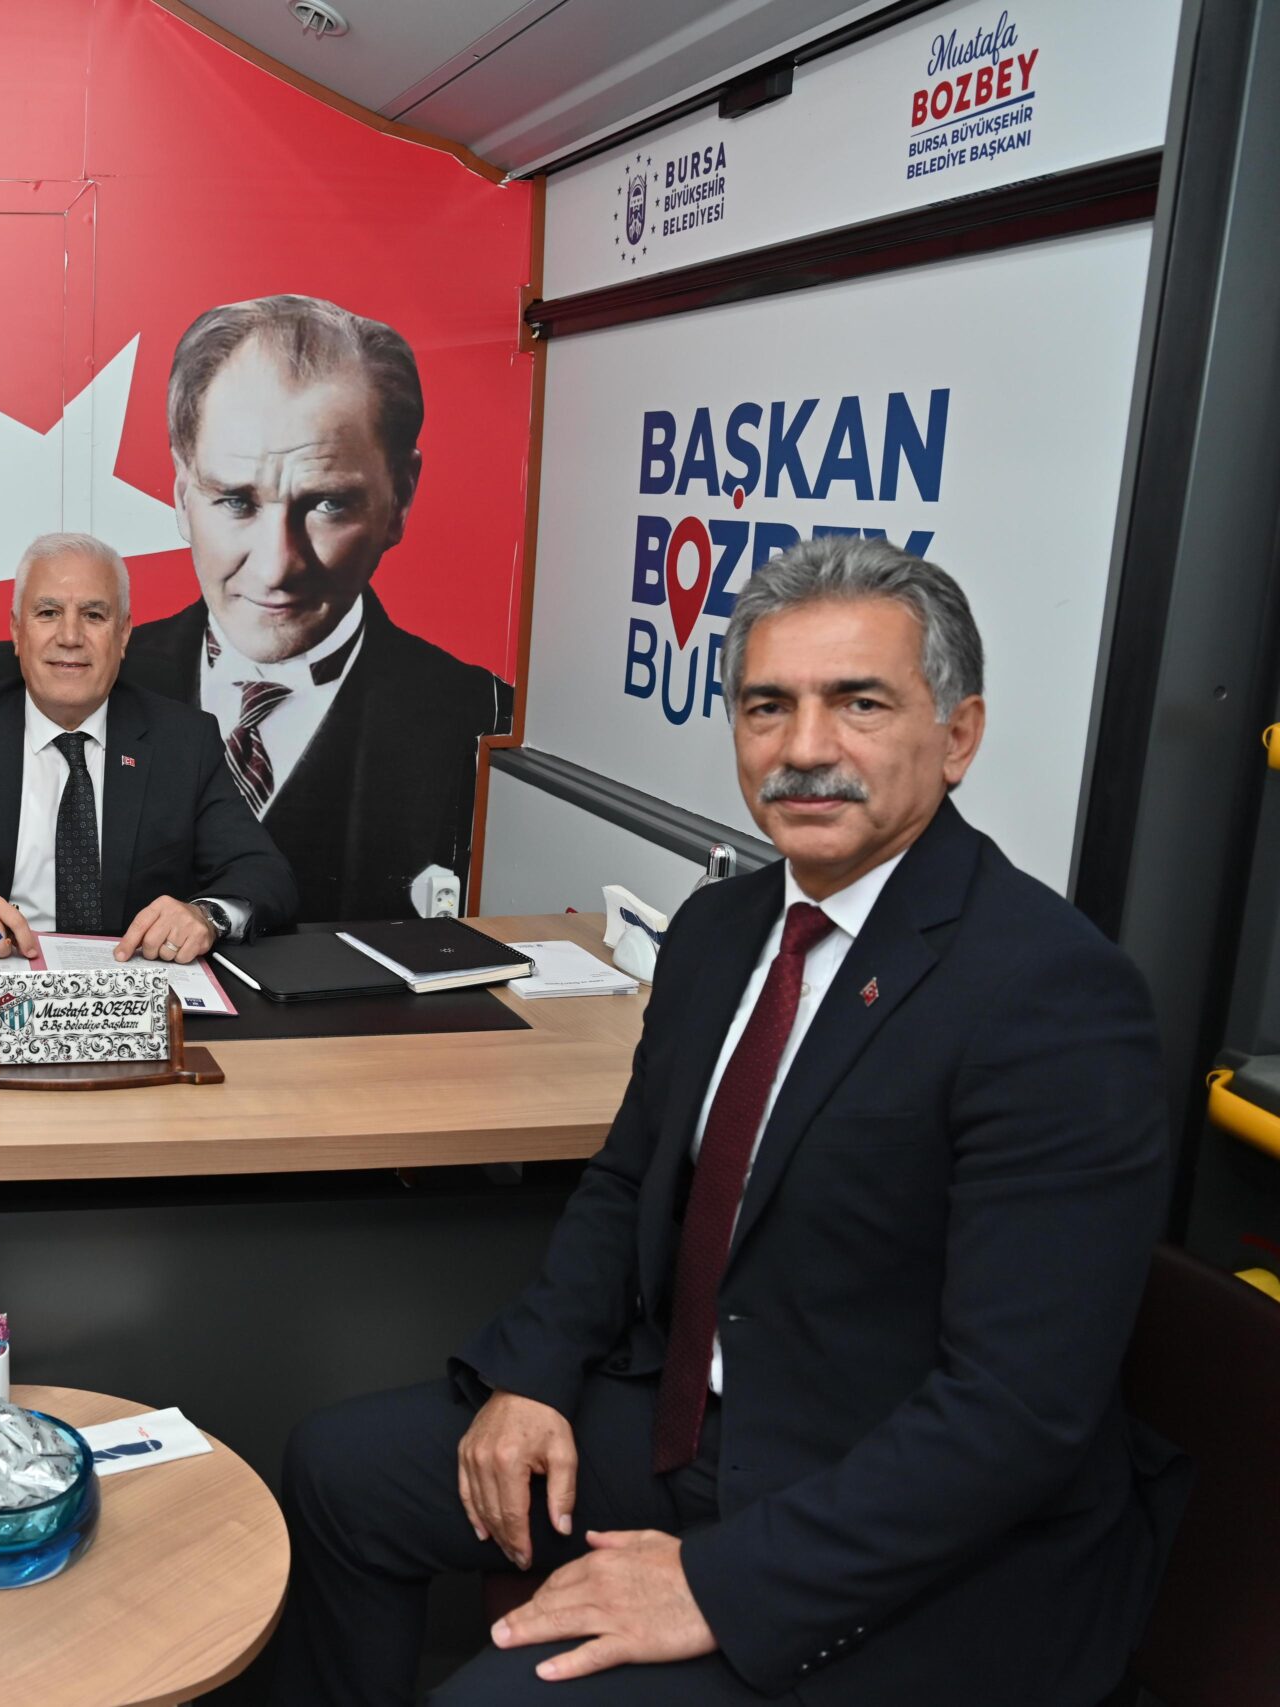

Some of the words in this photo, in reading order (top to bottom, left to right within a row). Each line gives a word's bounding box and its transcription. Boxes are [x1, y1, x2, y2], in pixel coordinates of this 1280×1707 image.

[927, 10, 1018, 76] Mustafa
[911, 48, 1039, 128] BOZBEY
[906, 149, 967, 179] BELEDİYE
[970, 129, 1032, 161] BAŞKANI
[908, 133, 948, 158] BURSA
[951, 104, 1033, 144] BÜYÜKŞEHİR
[665, 141, 726, 189] BURSA
[662, 197, 725, 236] BELEDİYESİ
[639, 388, 951, 509] BAŞKAN
[36, 1002, 90, 1019] Mustafa
[91, 1000, 150, 1017] BOZBEY
